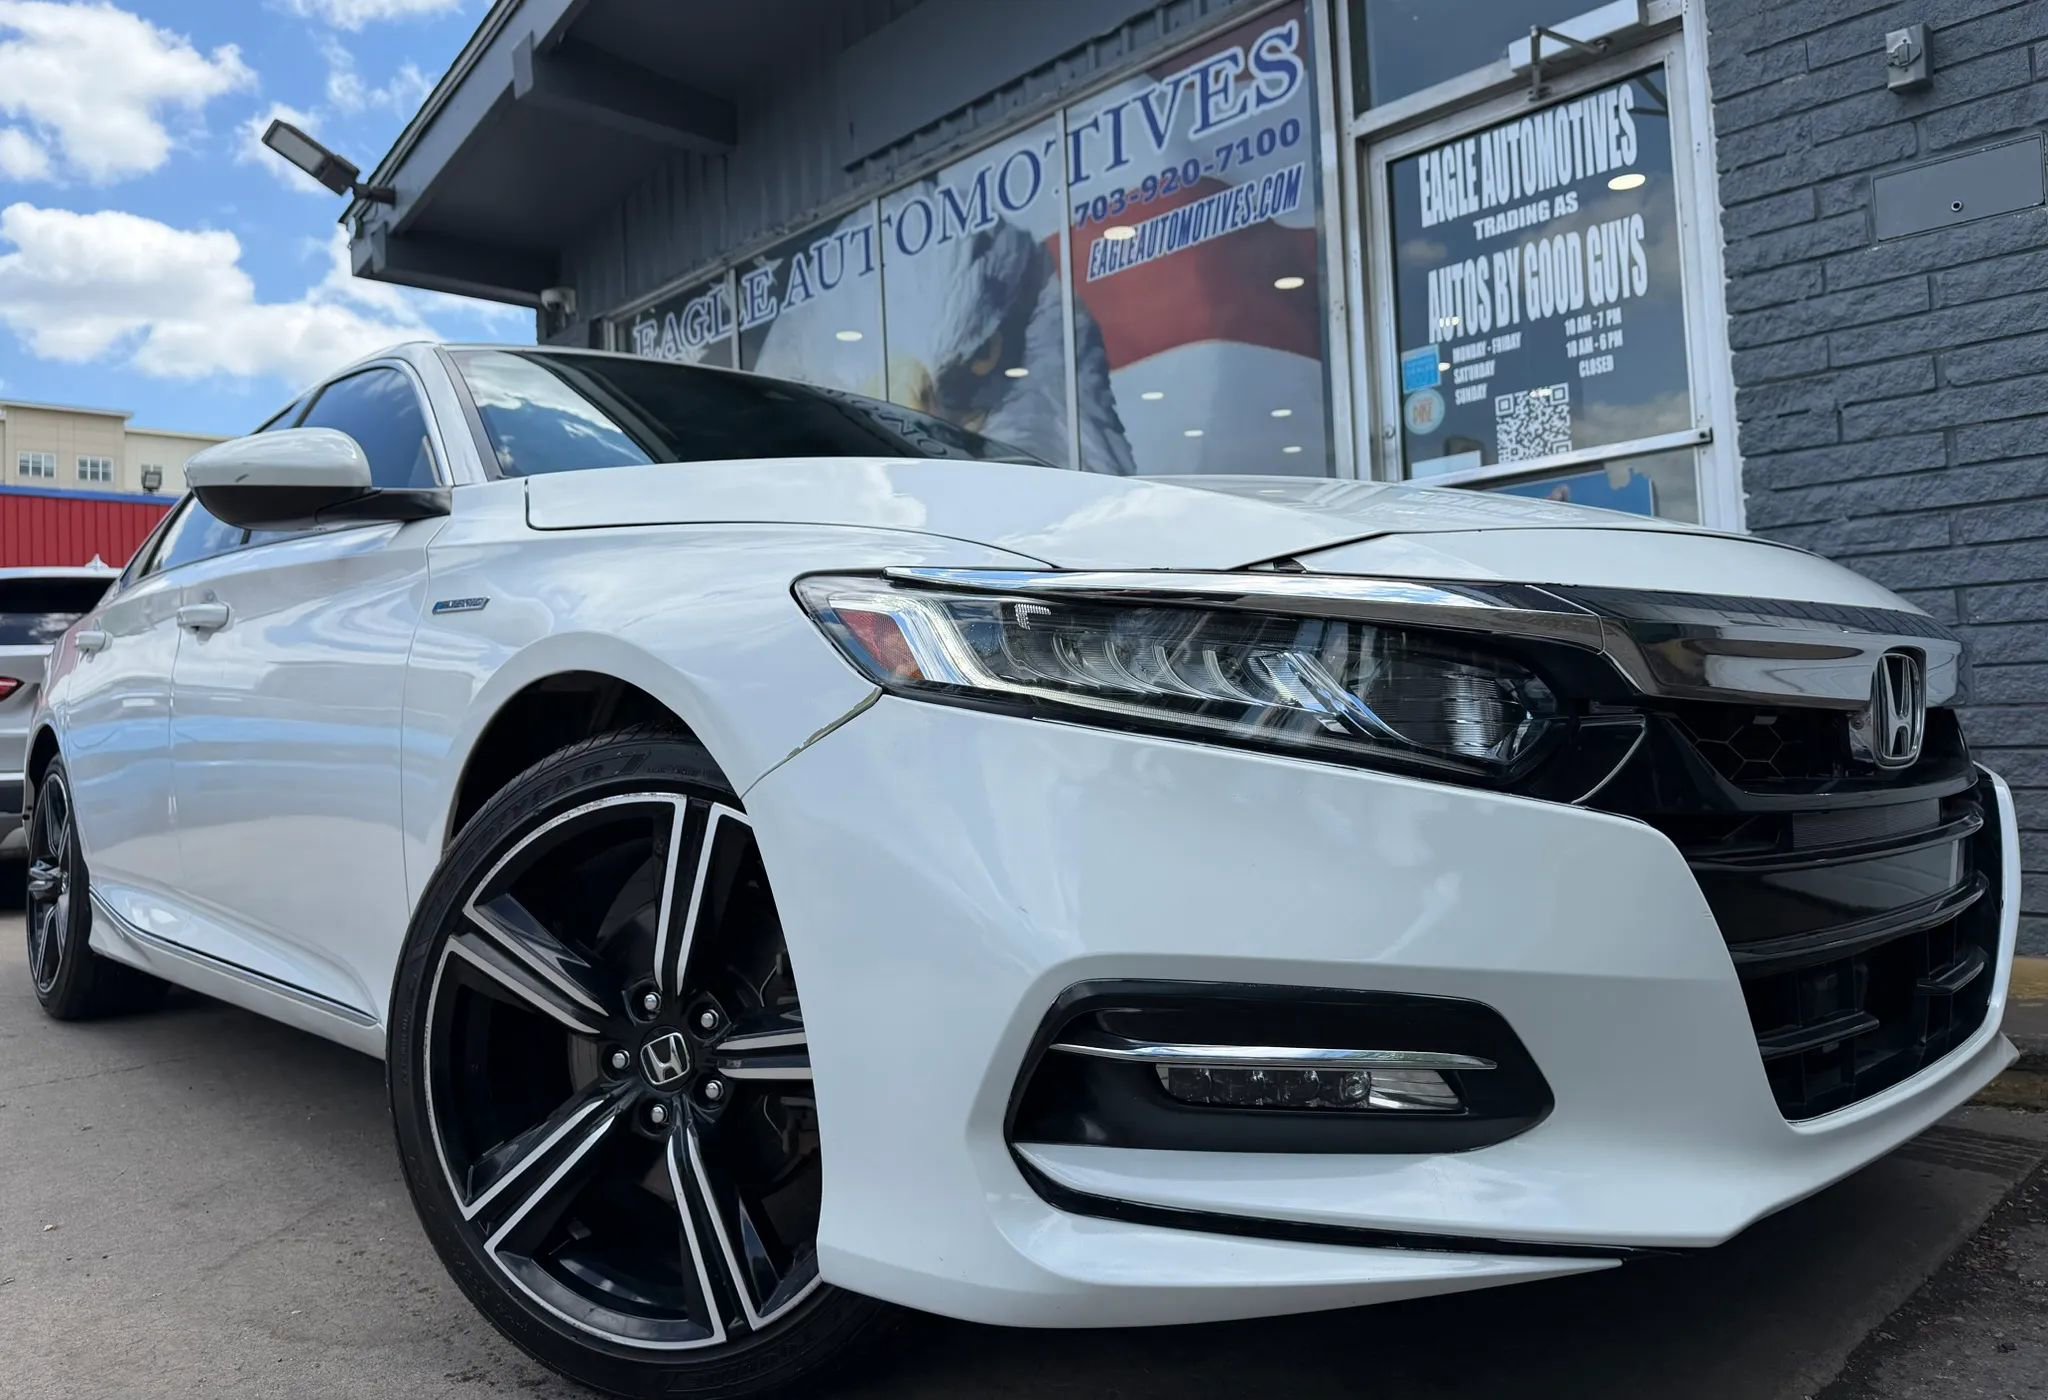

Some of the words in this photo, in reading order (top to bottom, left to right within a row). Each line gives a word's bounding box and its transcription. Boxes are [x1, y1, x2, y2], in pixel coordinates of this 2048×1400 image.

[1074, 117, 1301, 230] 703-920-7100
[1418, 137, 1479, 228] EAGLE
[1480, 84, 1639, 210] AUTOMOTIVES
[634, 268, 777, 357] EAGLE
[779, 20, 1303, 313] AUTOMOTIVES
[1088, 163, 1304, 281] EAGLEAUTOMOTIVES.COM
[1473, 199, 1551, 241] TRADING
[1553, 190, 1579, 218] AS
[1428, 254, 1492, 344] AUTOS
[1492, 246, 1520, 329] BY
[1523, 231, 1585, 322] GOOD
[1586, 213, 1649, 307] GUYS
[1577, 313, 1592, 334] AM
[1597, 310, 1604, 329] 7
[1605, 306, 1622, 327] PM
[1492, 331, 1522, 354] FRIDAY
[1579, 335, 1593, 356] AM
[1607, 328, 1623, 349] PM
[1453, 359, 1496, 385] SATURDAY
[1579, 353, 1614, 378] CLOSED
[1455, 382, 1488, 406] SUNDAY
